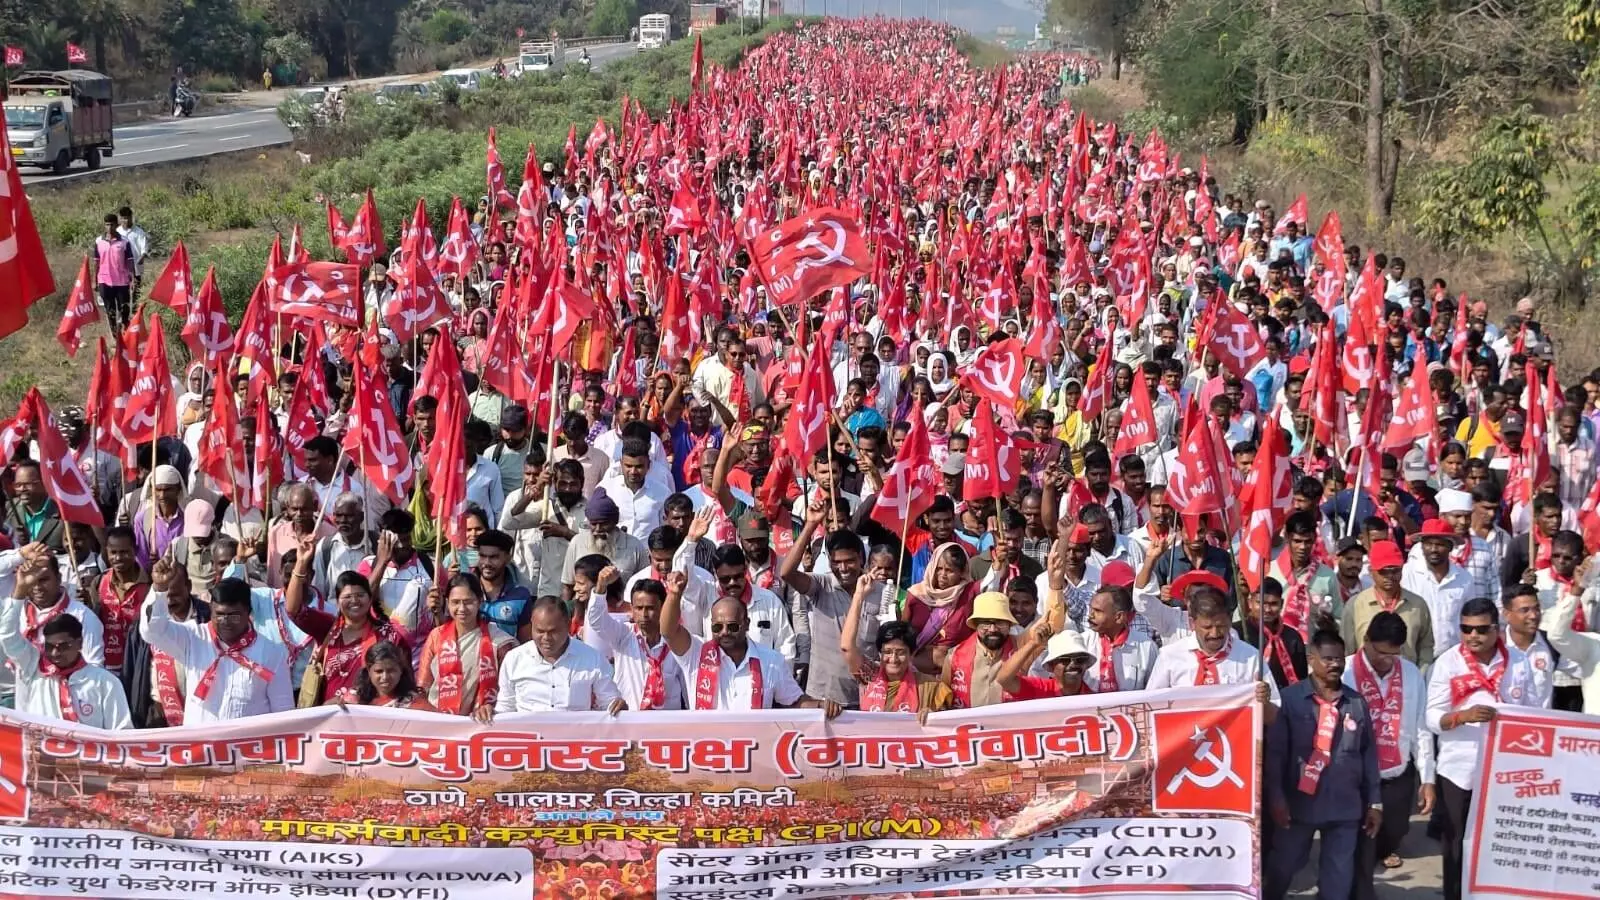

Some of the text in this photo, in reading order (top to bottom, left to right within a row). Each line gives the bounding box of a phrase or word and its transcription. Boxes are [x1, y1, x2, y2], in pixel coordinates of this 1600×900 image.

[320, 730, 631, 780] कम्युनिस्ट
[640, 737, 758, 771] पक्ष
[1495, 769, 1544, 784] धडक
[1514, 779, 1562, 798] मोर्चा
[404, 787, 468, 808] ठाणे
[494, 791, 596, 808] पालघर
[603, 788, 693, 808] जिल्हा
[700, 787, 797, 808] कमिटी
[261, 818, 942, 846] मार्क्सवादी कम्युनिस्ट पक्ष CPI(M)
[30, 834, 123, 850] भारतीय
[218, 848, 271, 862] सभा
[280, 850, 364, 867] (AIKS)
[668, 854, 735, 868] सेंटर
[745, 850, 813, 866] ऑफ
[825, 846, 922, 861] इंडियन
[1111, 826, 1217, 840] (CITU)
[28, 854, 122, 870] भारतीय
[130, 857, 222, 874] जनवादी
[405, 871, 522, 883] (AIDWA)
[668, 866, 810, 887] आदिवासी
[1043, 844, 1094, 859] मंच
[1104, 845, 1237, 859] (AARM)
[995, 865, 1081, 881] इंडिया
[1091, 864, 1167, 879] (SFI)
[66, 876, 110, 892] युथ
[117, 874, 217, 893] फेडरेशन
[224, 878, 281, 895] ऑफ
[289, 882, 360, 898] इंडिया
[367, 886, 450, 900] (DYFI)
